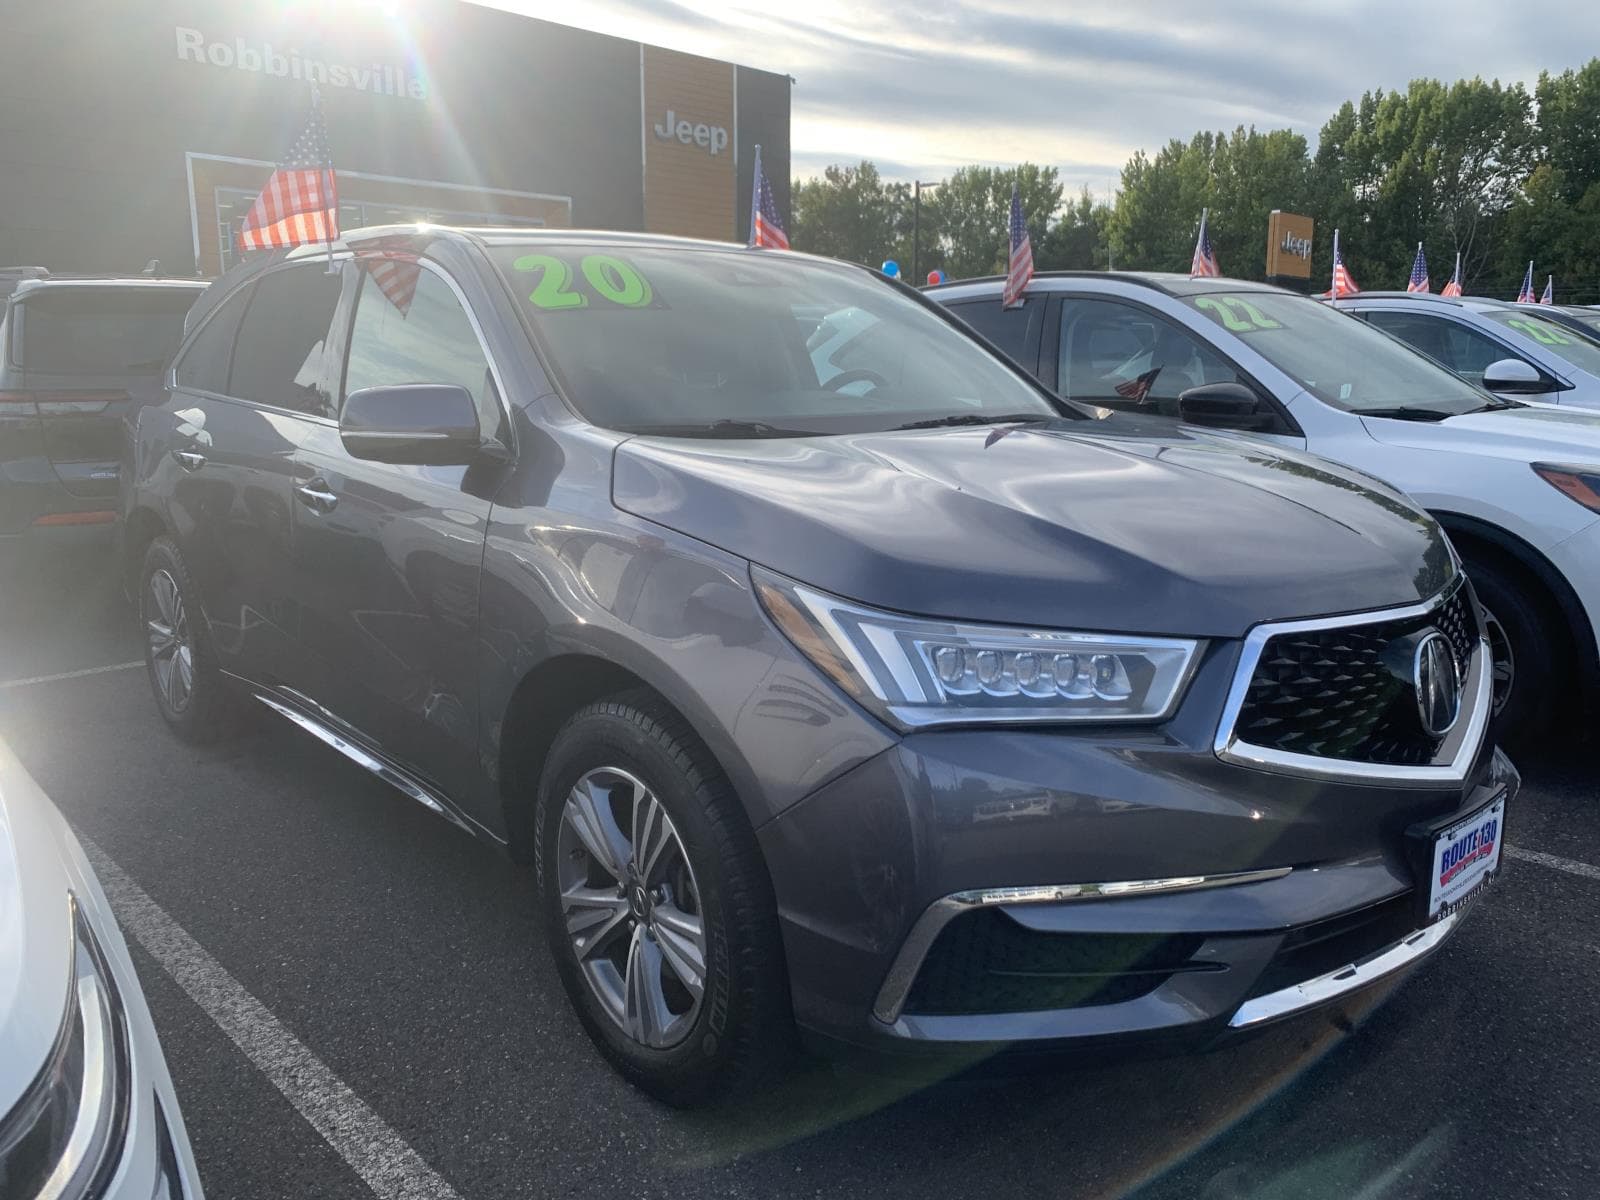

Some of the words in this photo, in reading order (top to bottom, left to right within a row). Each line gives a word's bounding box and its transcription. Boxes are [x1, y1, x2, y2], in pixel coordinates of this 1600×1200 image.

[175, 26, 428, 99] Robbinsville
[654, 110, 728, 154] Jeep
[1281, 231, 1312, 260] Jeep
[513, 254, 653, 309] 20
[1194, 297, 1283, 332] 22
[1441, 828, 1479, 874] ROUTE
[1480, 818, 1498, 845] 130
